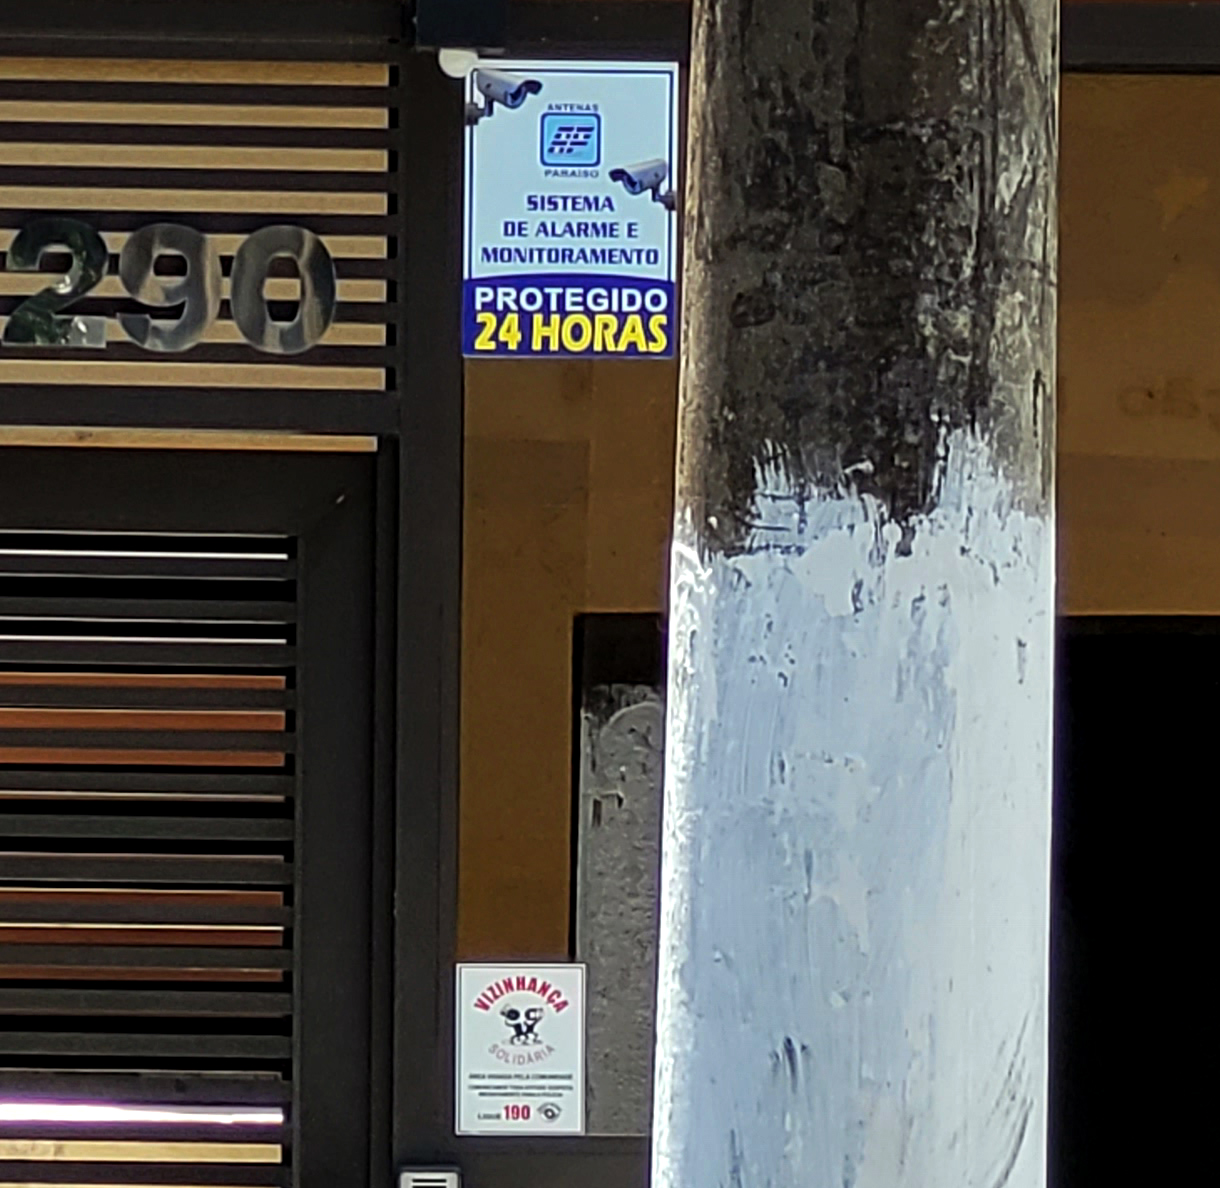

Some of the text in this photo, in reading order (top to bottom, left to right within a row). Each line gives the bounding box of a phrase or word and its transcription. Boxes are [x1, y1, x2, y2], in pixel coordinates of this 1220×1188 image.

[547, 103, 599, 111] ANTENAS
[526, 195, 615, 212] SISTEMA
[503, 221, 638, 238] DE ALARME E
[481, 247, 659, 265] MONITORAMENTO
[2, 217, 337, 354] 290
[474, 286, 668, 312] PROTEGIDO
[474, 313, 668, 352] 24 HORAS
[474, 976, 569, 1013] VIZINHANÇA
[488, 1043, 555, 1066] SOLIDÁRIA
[504, 1104, 531, 1121] 190
